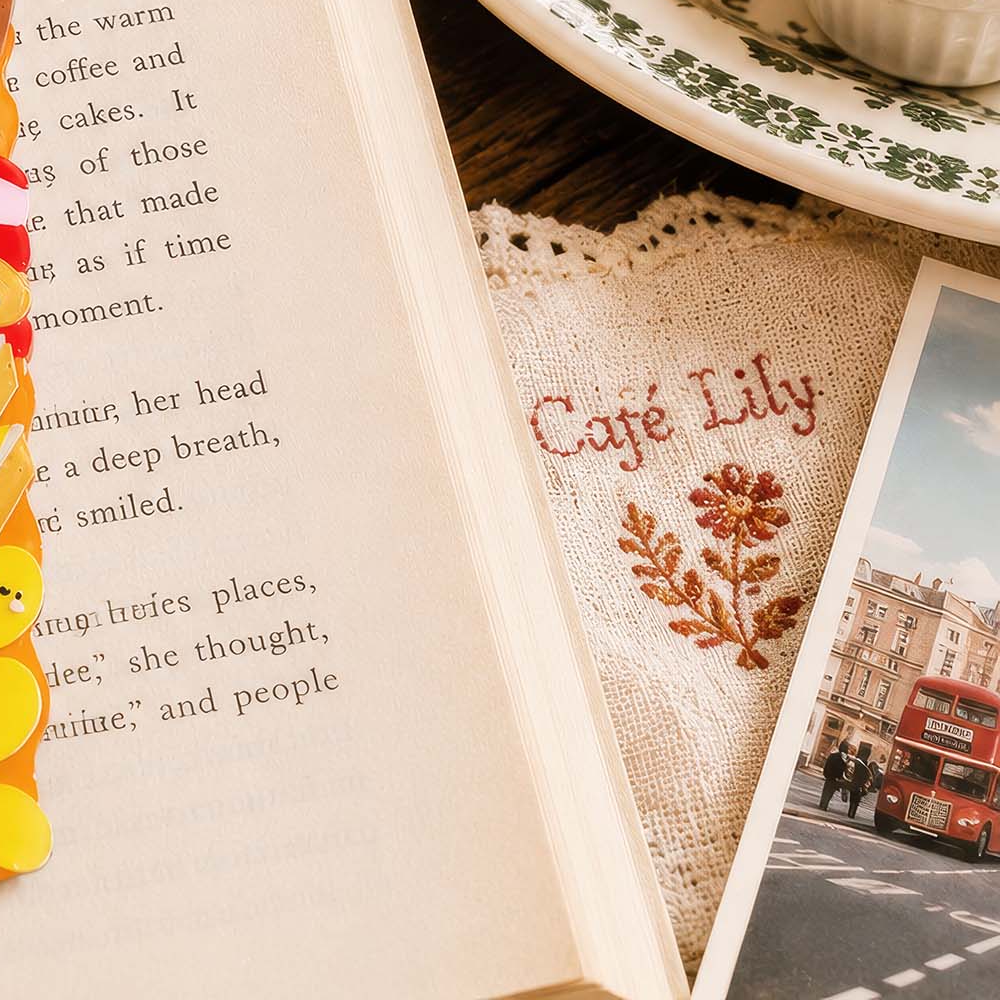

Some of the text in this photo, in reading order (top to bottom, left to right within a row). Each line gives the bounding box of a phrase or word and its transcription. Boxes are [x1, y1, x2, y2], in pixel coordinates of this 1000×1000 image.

[35, 6, 176, 42] the warm
[35, 41, 186, 88] coffee and
[59, 88, 198, 131] cakes. It
[79, 139, 209, 176] of those
[63, 180, 220, 227] that made
[76, 233, 232, 274] as if time
[31, 294, 164, 331] moment.
[130, 390, 181, 417] her
[194, 369, 269, 406] head
[530, 352, 816, 472] Café Lily
[64, 461, 81, 479] a
[91, 446, 162, 473] deep
[170, 421, 280, 460] breath,
[76, 486, 183, 528] smiled.
[211, 574, 317, 615] places,
[128, 645, 180, 674] she
[193, 619, 329, 662] thought,
[159, 686, 219, 721] and
[232, 666, 340, 717] people
